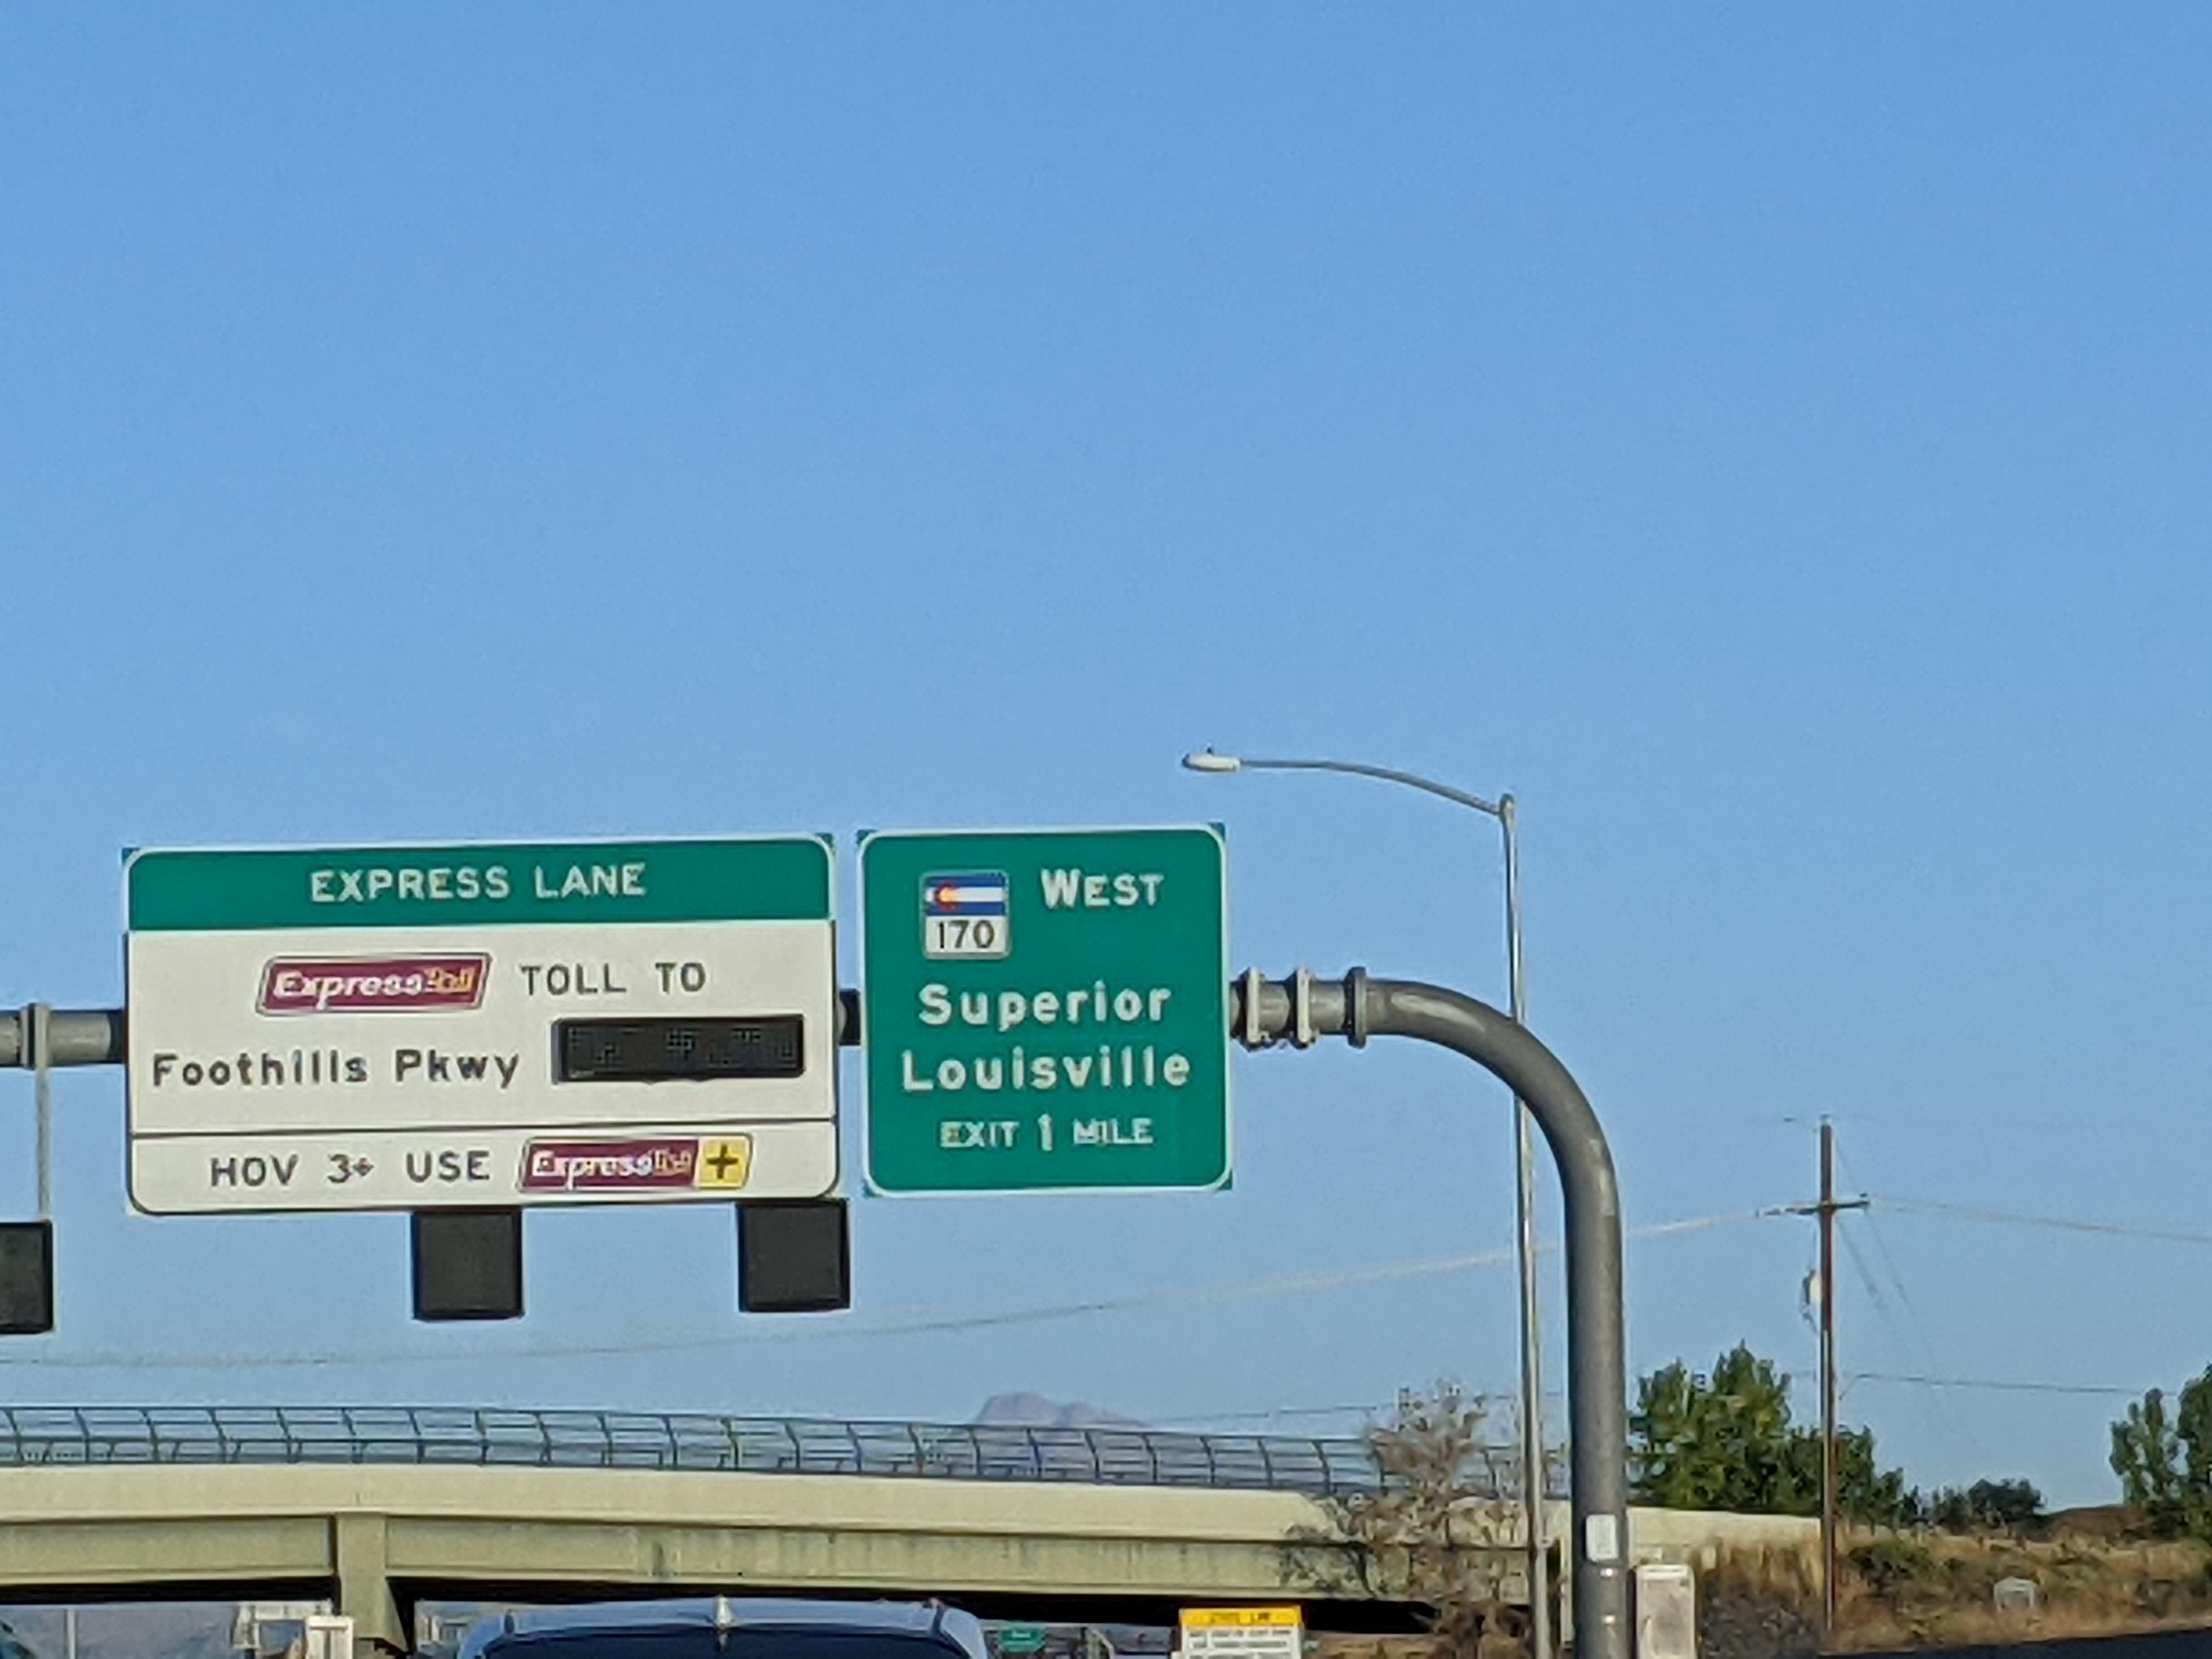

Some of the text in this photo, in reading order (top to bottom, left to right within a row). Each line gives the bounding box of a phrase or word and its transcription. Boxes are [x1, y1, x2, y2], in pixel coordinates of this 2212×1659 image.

[310, 862, 647, 903] EXPRESS LANE
[1040, 868, 1164, 909] WEST
[936, 919, 995, 950] 170
[520, 963, 627, 996] TOLL
[654, 962, 707, 994] TO
[918, 979, 1172, 1031] Superior
[152, 1049, 520, 1090] Foothills Pkwy
[901, 1046, 1191, 1091] Louisville
[940, 1114, 1154, 1152] EXIT 1 MILE
[211, 1154, 298, 1187] HOV
[327, 1154, 375, 1184] 3+
[405, 1151, 490, 1183] USE
